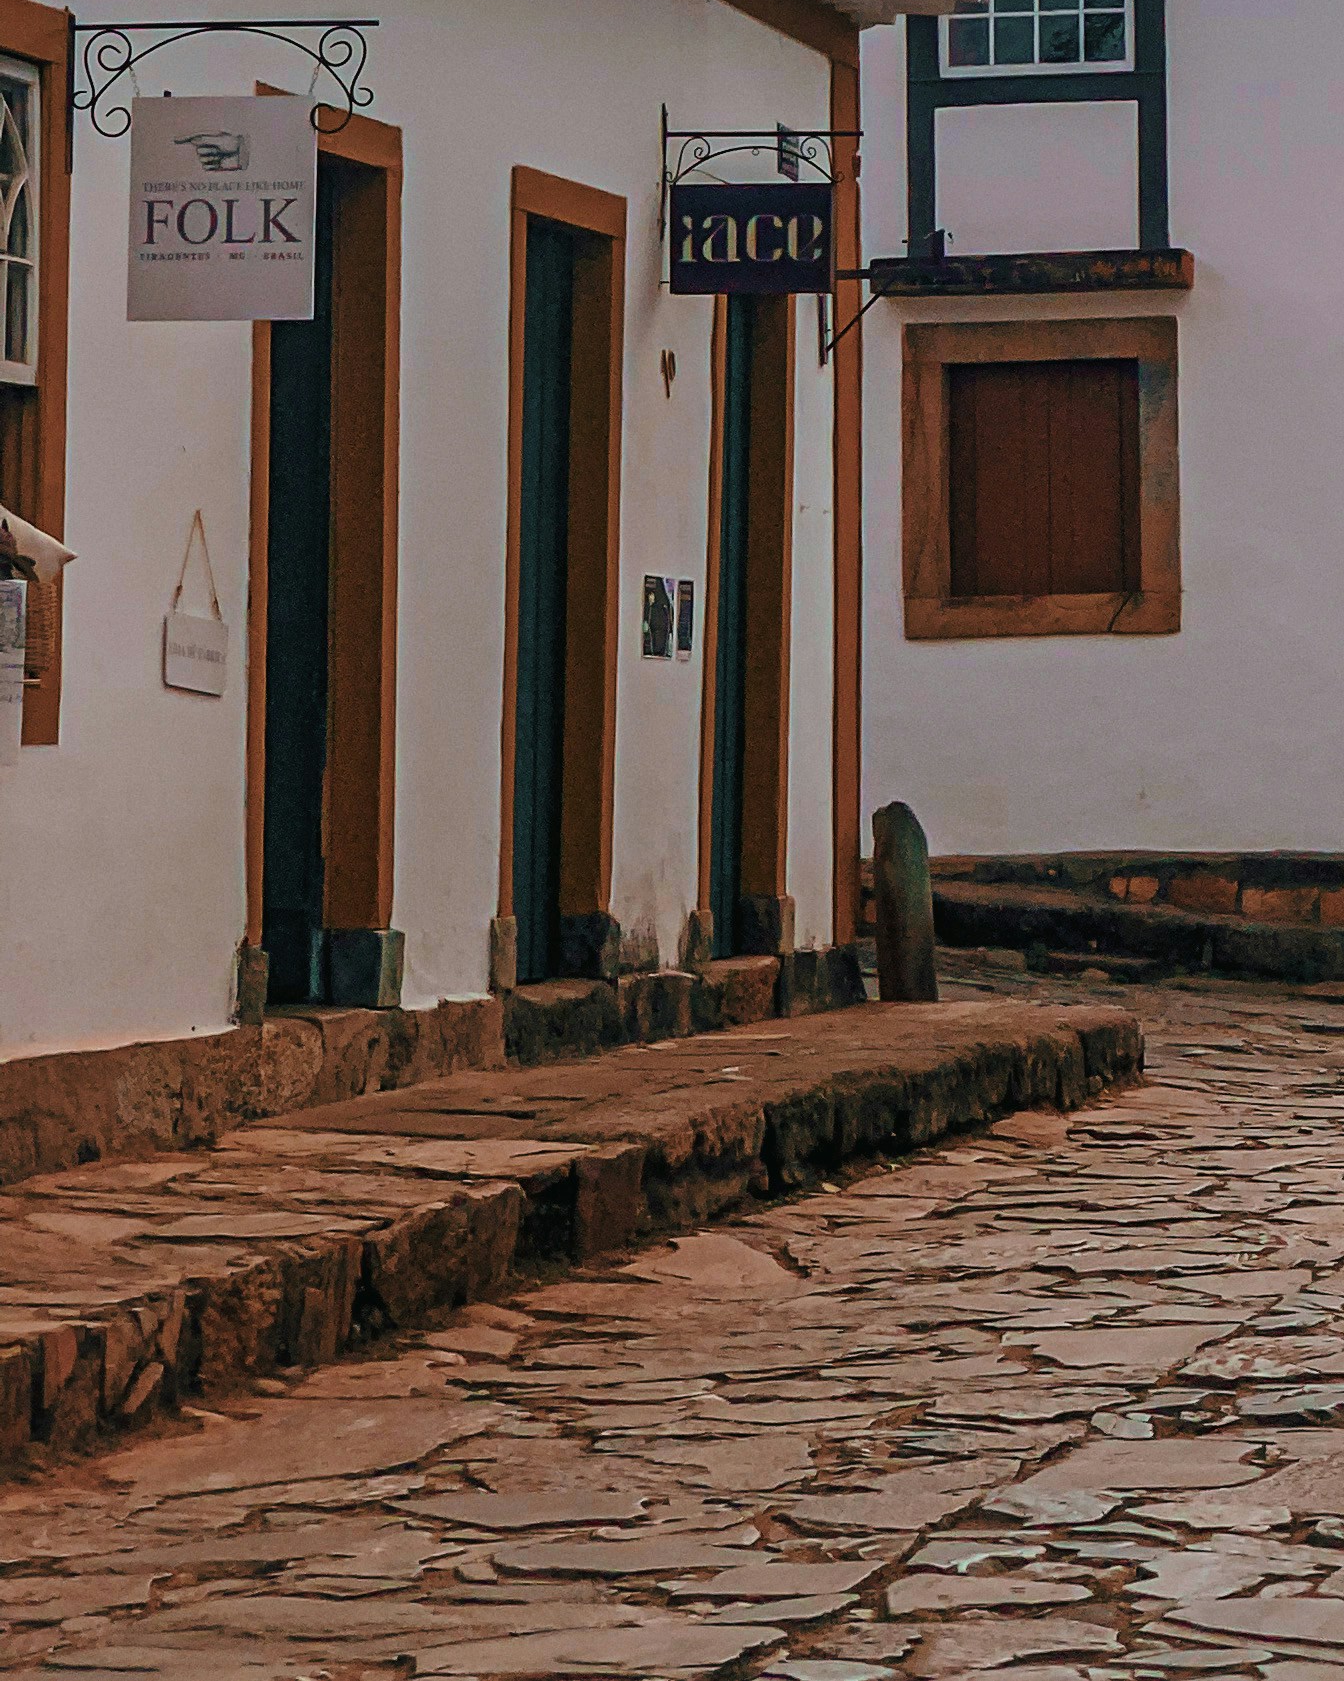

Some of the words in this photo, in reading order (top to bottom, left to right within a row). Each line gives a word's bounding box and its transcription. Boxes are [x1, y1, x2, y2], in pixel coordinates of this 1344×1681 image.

[272, 180, 305, 191] HOME
[142, 198, 302, 245] FOLK
[678, 214, 824, 263] iace
[139, 251, 211, 261] TIRADENTES
[229, 251, 246, 261] MG
[262, 251, 304, 261] BRASIL
